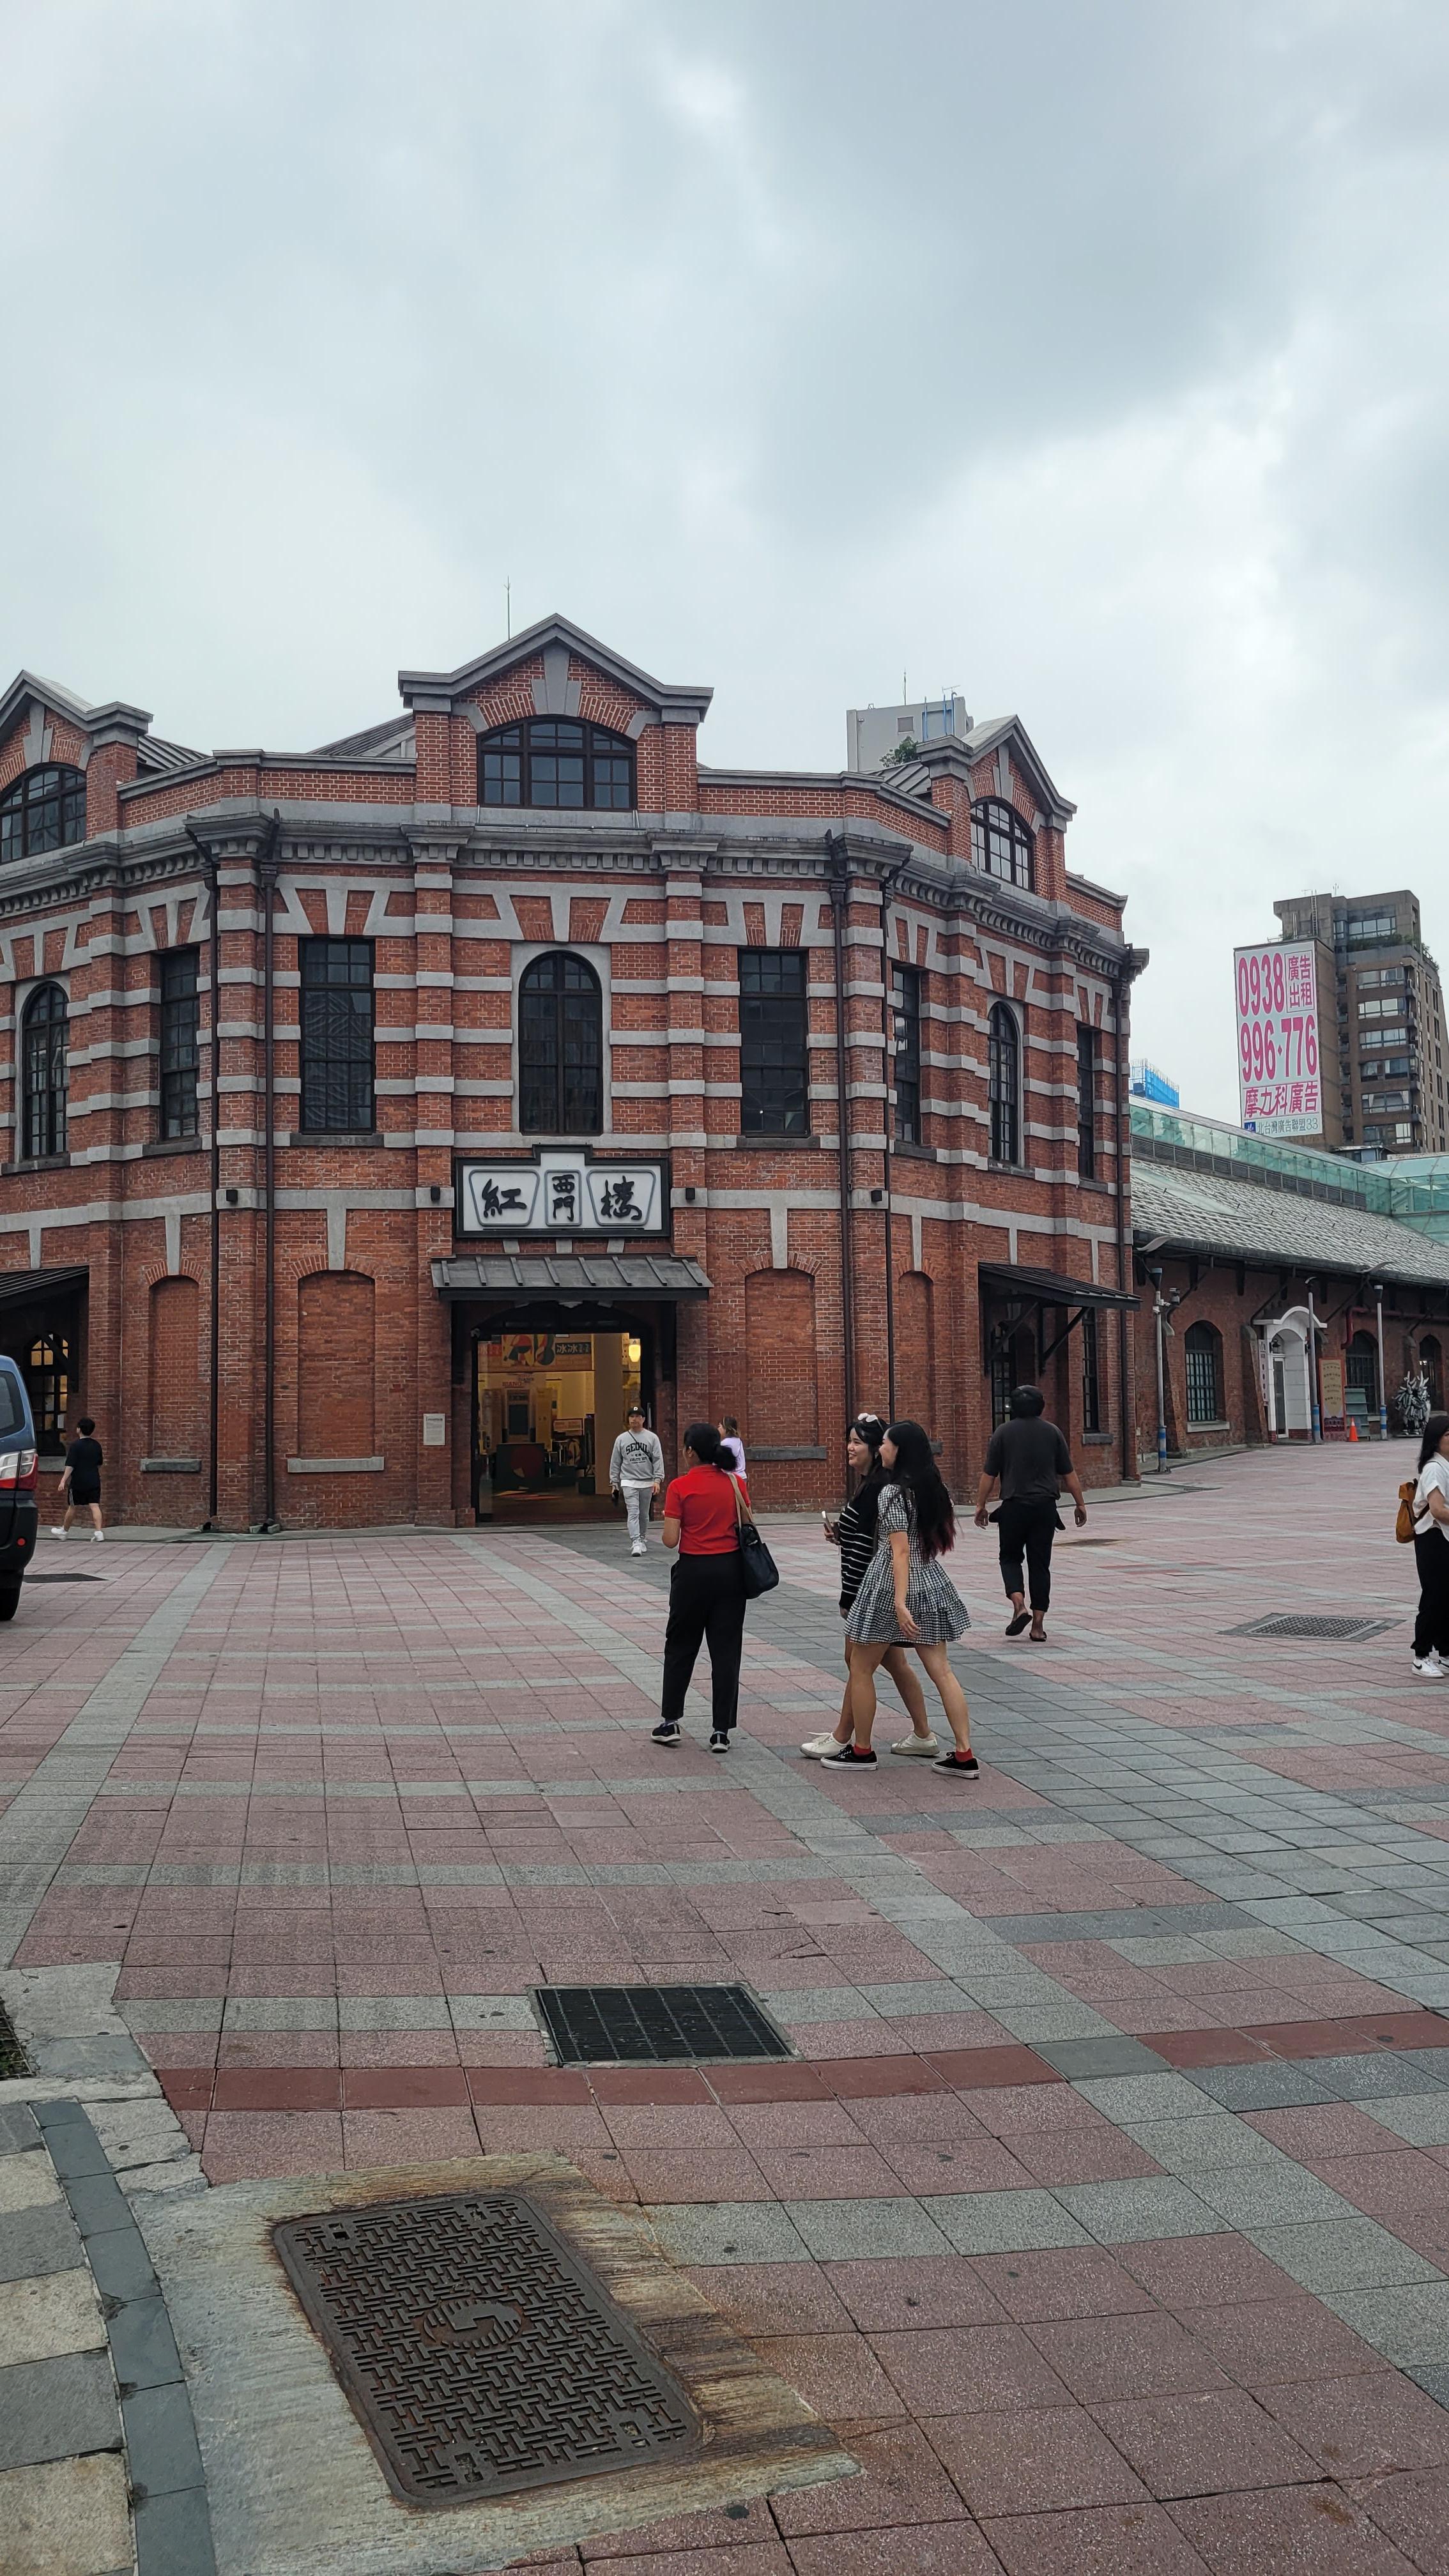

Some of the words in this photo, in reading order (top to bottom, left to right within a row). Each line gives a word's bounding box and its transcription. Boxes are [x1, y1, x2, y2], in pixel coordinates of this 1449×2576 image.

[1288, 954, 1311, 981] 廣告
[1239, 953, 1284, 1017] 0938
[1289, 981, 1313, 1008] 出租
[1245, 1081, 1318, 1118] 摩力科廣告
[626, 1441, 649, 1455] SEOUL
